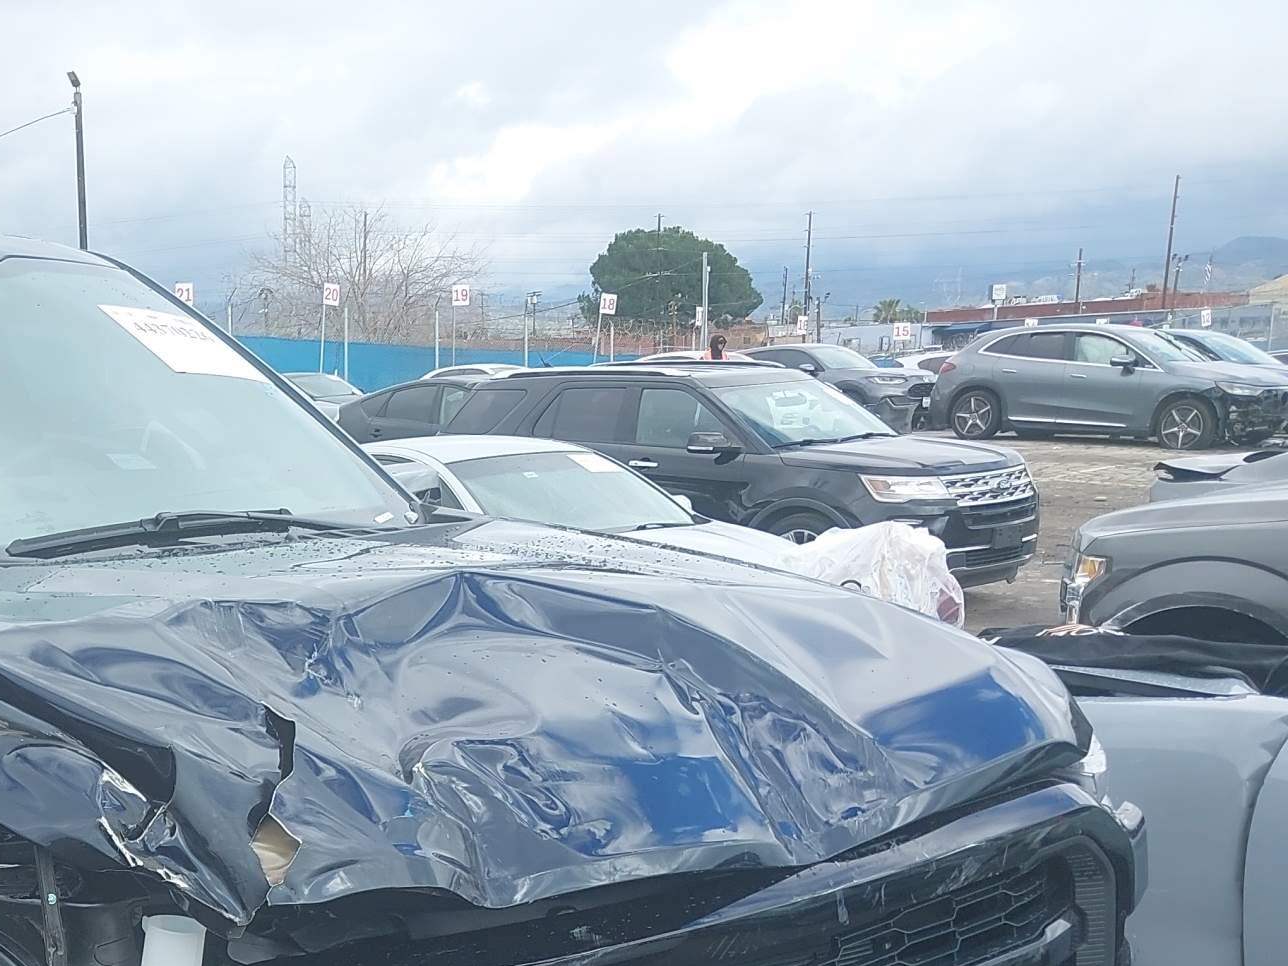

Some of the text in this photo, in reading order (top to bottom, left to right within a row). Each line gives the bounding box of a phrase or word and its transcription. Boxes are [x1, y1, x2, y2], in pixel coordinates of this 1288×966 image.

[176, 287, 192, 302] 21
[325, 287, 339, 302] 20
[454, 289, 468, 302] 19
[601, 298, 615, 311] 18
[896, 326, 909, 337] 15
